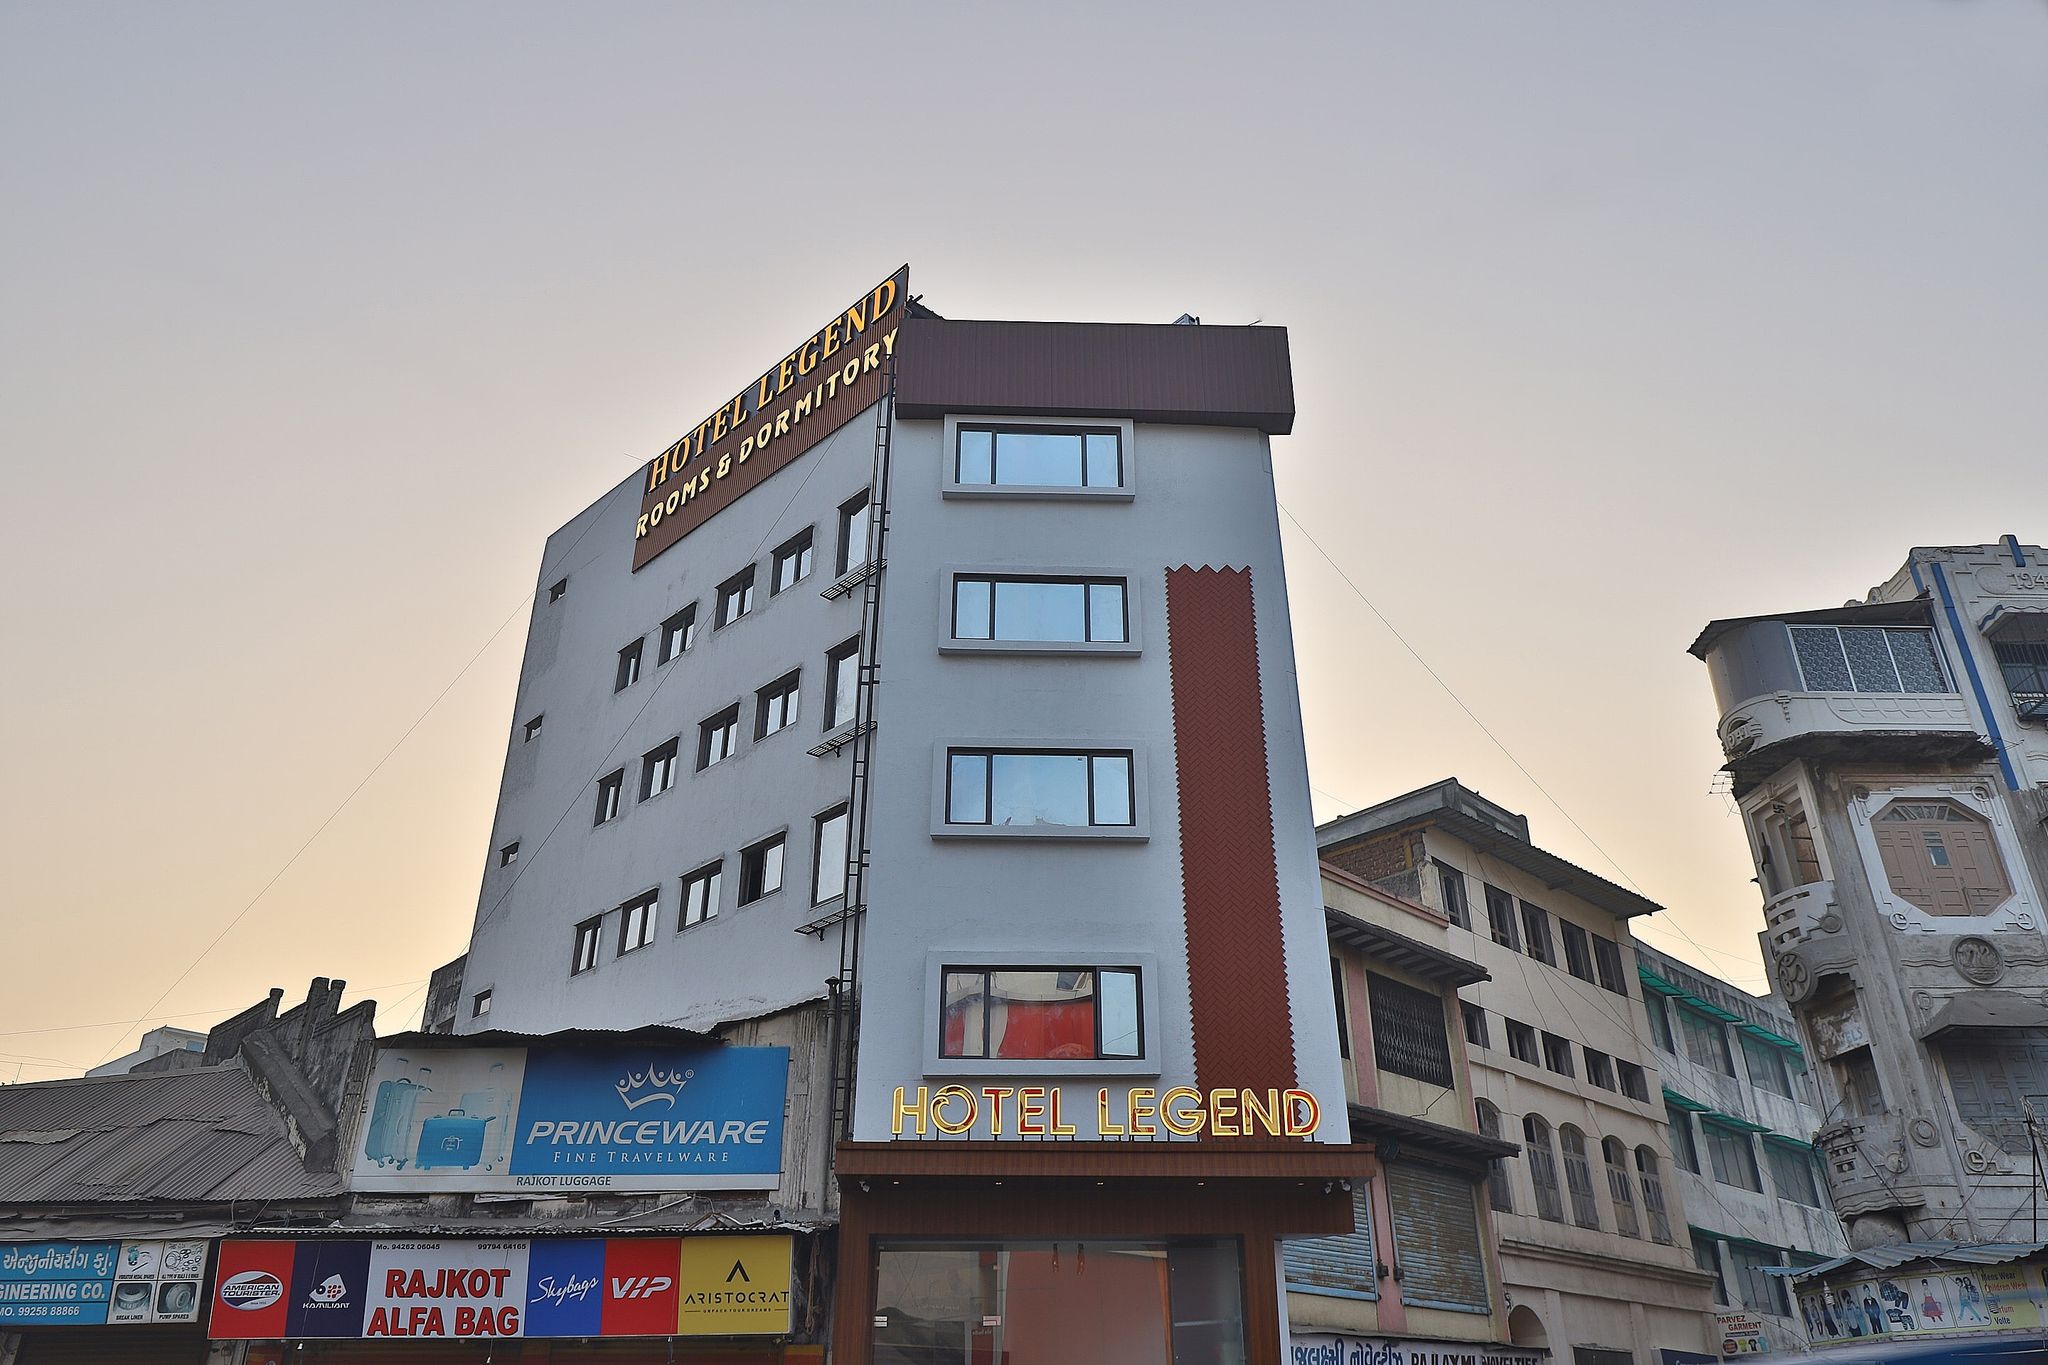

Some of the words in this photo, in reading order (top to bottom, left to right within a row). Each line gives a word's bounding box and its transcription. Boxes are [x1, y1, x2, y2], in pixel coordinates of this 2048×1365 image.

[647, 393, 747, 493] HOTEL
[757, 278, 897, 411] LEGEND
[635, 466, 711, 540] ROOMS
[717, 453, 731, 479] &
[739, 326, 899, 464] DORMITORY
[891, 1084, 1076, 1136] HOTEL
[1098, 1086, 1321, 1137] LEGEND
[526, 1120, 769, 1145] PRINCEWARE
[553, 1151, 597, 1163] FINE
[608, 1151, 729, 1163] TRAVELWARE
[516, 1176, 558, 1187] RAJKOT
[560, 1175, 612, 1186] LUGGAGE
[81, 1283, 105, 1300] CO.
[385, 1268, 511, 1298] RAJKOT
[530, 1274, 600, 1307] Skybags
[611, 1276, 673, 1300] VIP
[685, 1291, 789, 1305] ARISTOCRAT
[18, 1306, 47, 1316] 99258
[50, 1305, 80, 1316] 88866
[366, 1306, 445, 1337] ALFA
[454, 1306, 520, 1337] BAG
[1717, 1315, 1746, 1324] PARVEZ
[1728, 1322, 1762, 1331] GARMENT
